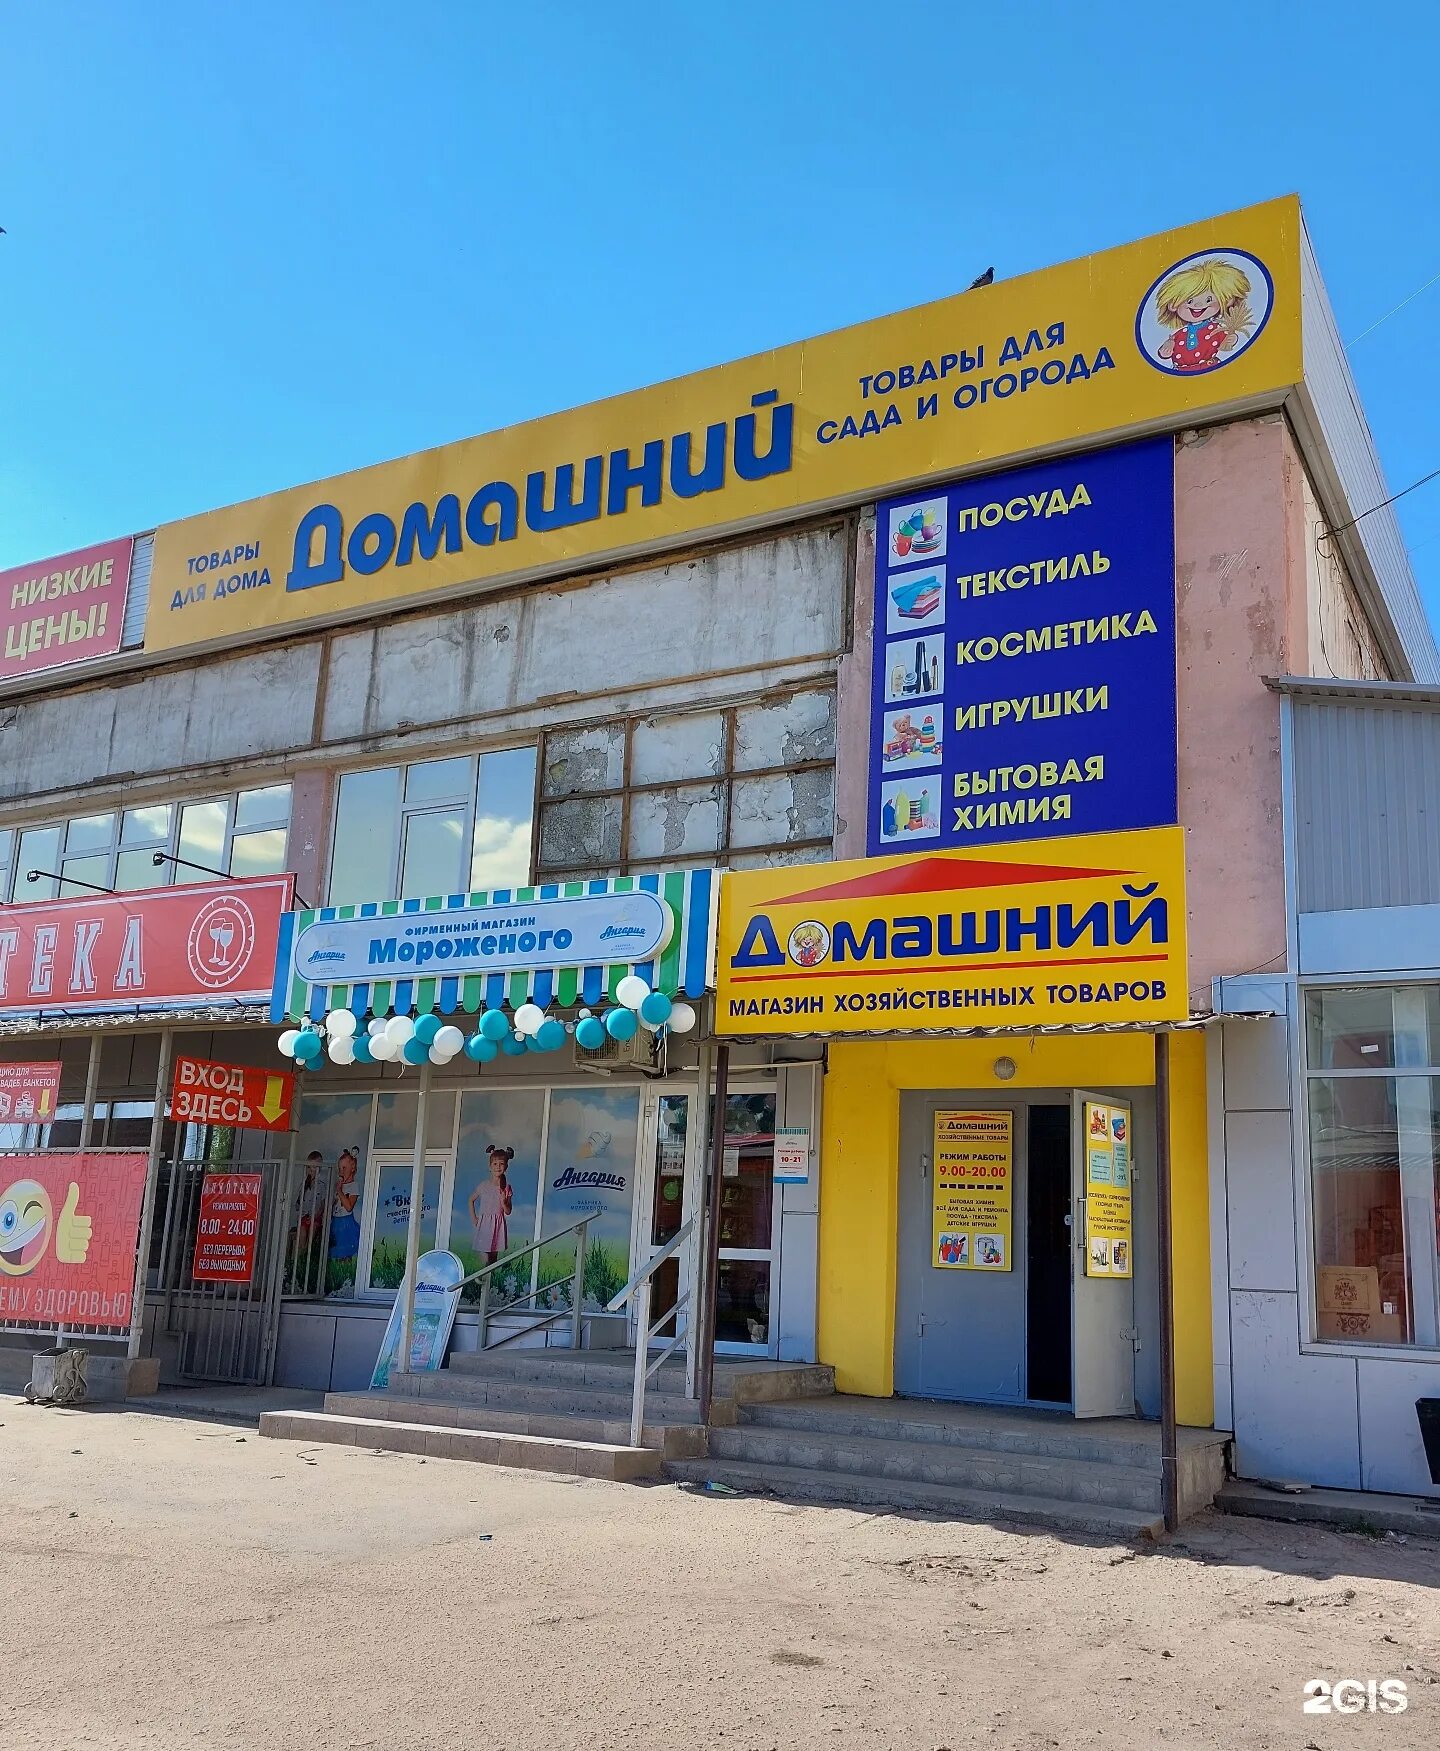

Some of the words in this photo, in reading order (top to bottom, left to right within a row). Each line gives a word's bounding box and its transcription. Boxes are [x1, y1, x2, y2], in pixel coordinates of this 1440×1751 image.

[858, 346, 983, 399] ТОВАРЫ
[999, 322, 1065, 366] ДЛЯ
[816, 404, 902, 443] САДА
[917, 393, 938, 419] И
[953, 346, 1115, 408] ОГОРОДА
[286, 389, 793, 593] Домашний
[959, 484, 1091, 533] ПОСУДА
[187, 541, 260, 575] ТОВАРЫ
[956, 550, 1110, 599] ТЕКСТИЛЬ
[10, 559, 114, 610] НИЗКИЕ
[170, 583, 206, 611] ДЛЯ
[213, 567, 271, 599] ДОМА
[4, 602, 109, 661] ЦЕНЫ!
[956, 610, 1157, 665] КОСМЕТИКА
[955, 686, 1108, 731] ИГРУШКИ
[953, 755, 1104, 798] БЫТОВАЯ
[952, 794, 1071, 832] ХИМИЯ
[405, 919, 479, 937] ФИРМЕННЫЙ
[481, 916, 536, 931] МАГАЗИН
[600, 925, 646, 941] Ангария
[730, 882, 1168, 968] Домашний
[307, 950, 346, 964] Ангария
[368, 926, 573, 965] Мороженого
[730, 996, 825, 1017] МАГАЗИН
[834, 985, 1035, 1013] ХОЗЯЙСТВЕННЫХ
[1046, 980, 1167, 1005] ТОВАРОВ
[16, 1067, 30, 1077] ДЛЯ
[23, 1079, 56, 1087] БАНКЕТОВ
[179, 1061, 244, 1096] ВХОД
[176, 1091, 252, 1122] ЗДЕСЬ
[947, 1121, 1008, 1131] Домашний
[939, 1153, 970, 1161] РЕЖИМ
[972, 1153, 1007, 1161] РАБОТЫ
[939, 1165, 1007, 1178] 9.00-20.00
[553, 1167, 626, 1190] Ангария
[201, 1218, 220, 1234] 8.00
[228, 1219, 255, 1236] 24.00
[199, 1258, 210, 1270] БЕЗ
[210, 1259, 246, 1272] ВЫХОДНЫХ
[202, 1244, 214, 1255] БЕЗ
[34, 1288, 127, 1318] ЗДОРОВЬЮ
